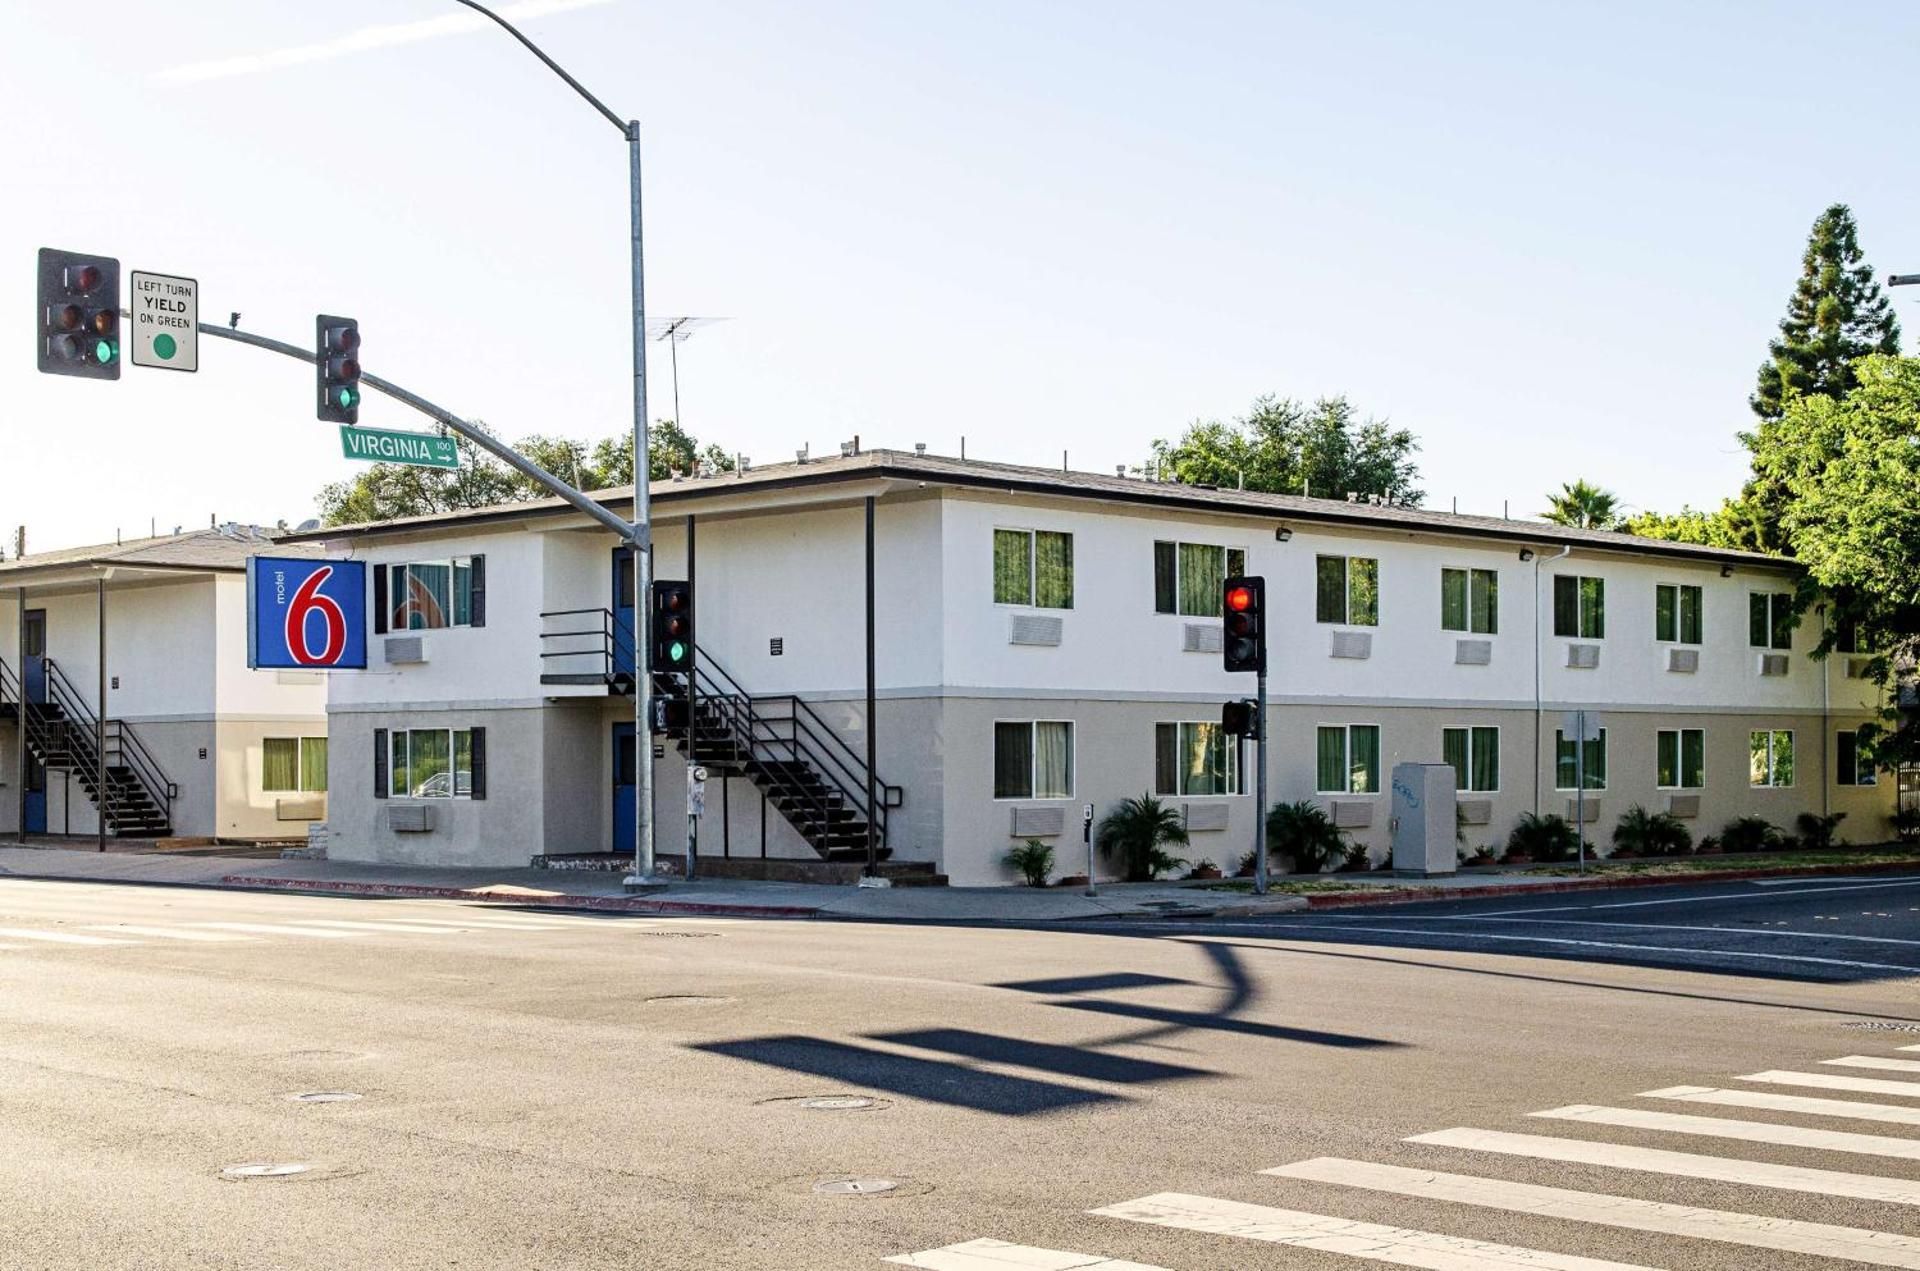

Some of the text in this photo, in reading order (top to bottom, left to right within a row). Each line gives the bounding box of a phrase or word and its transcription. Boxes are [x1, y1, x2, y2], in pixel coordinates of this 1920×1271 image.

[138, 280, 191, 297] LEFT TURN
[144, 296, 186, 313] YIELD
[140, 313, 190, 328] ON GREEN
[347, 433, 451, 460] VIRGINIA 100
[274, 571, 285, 604] motel
[285, 565, 347, 665] 6
